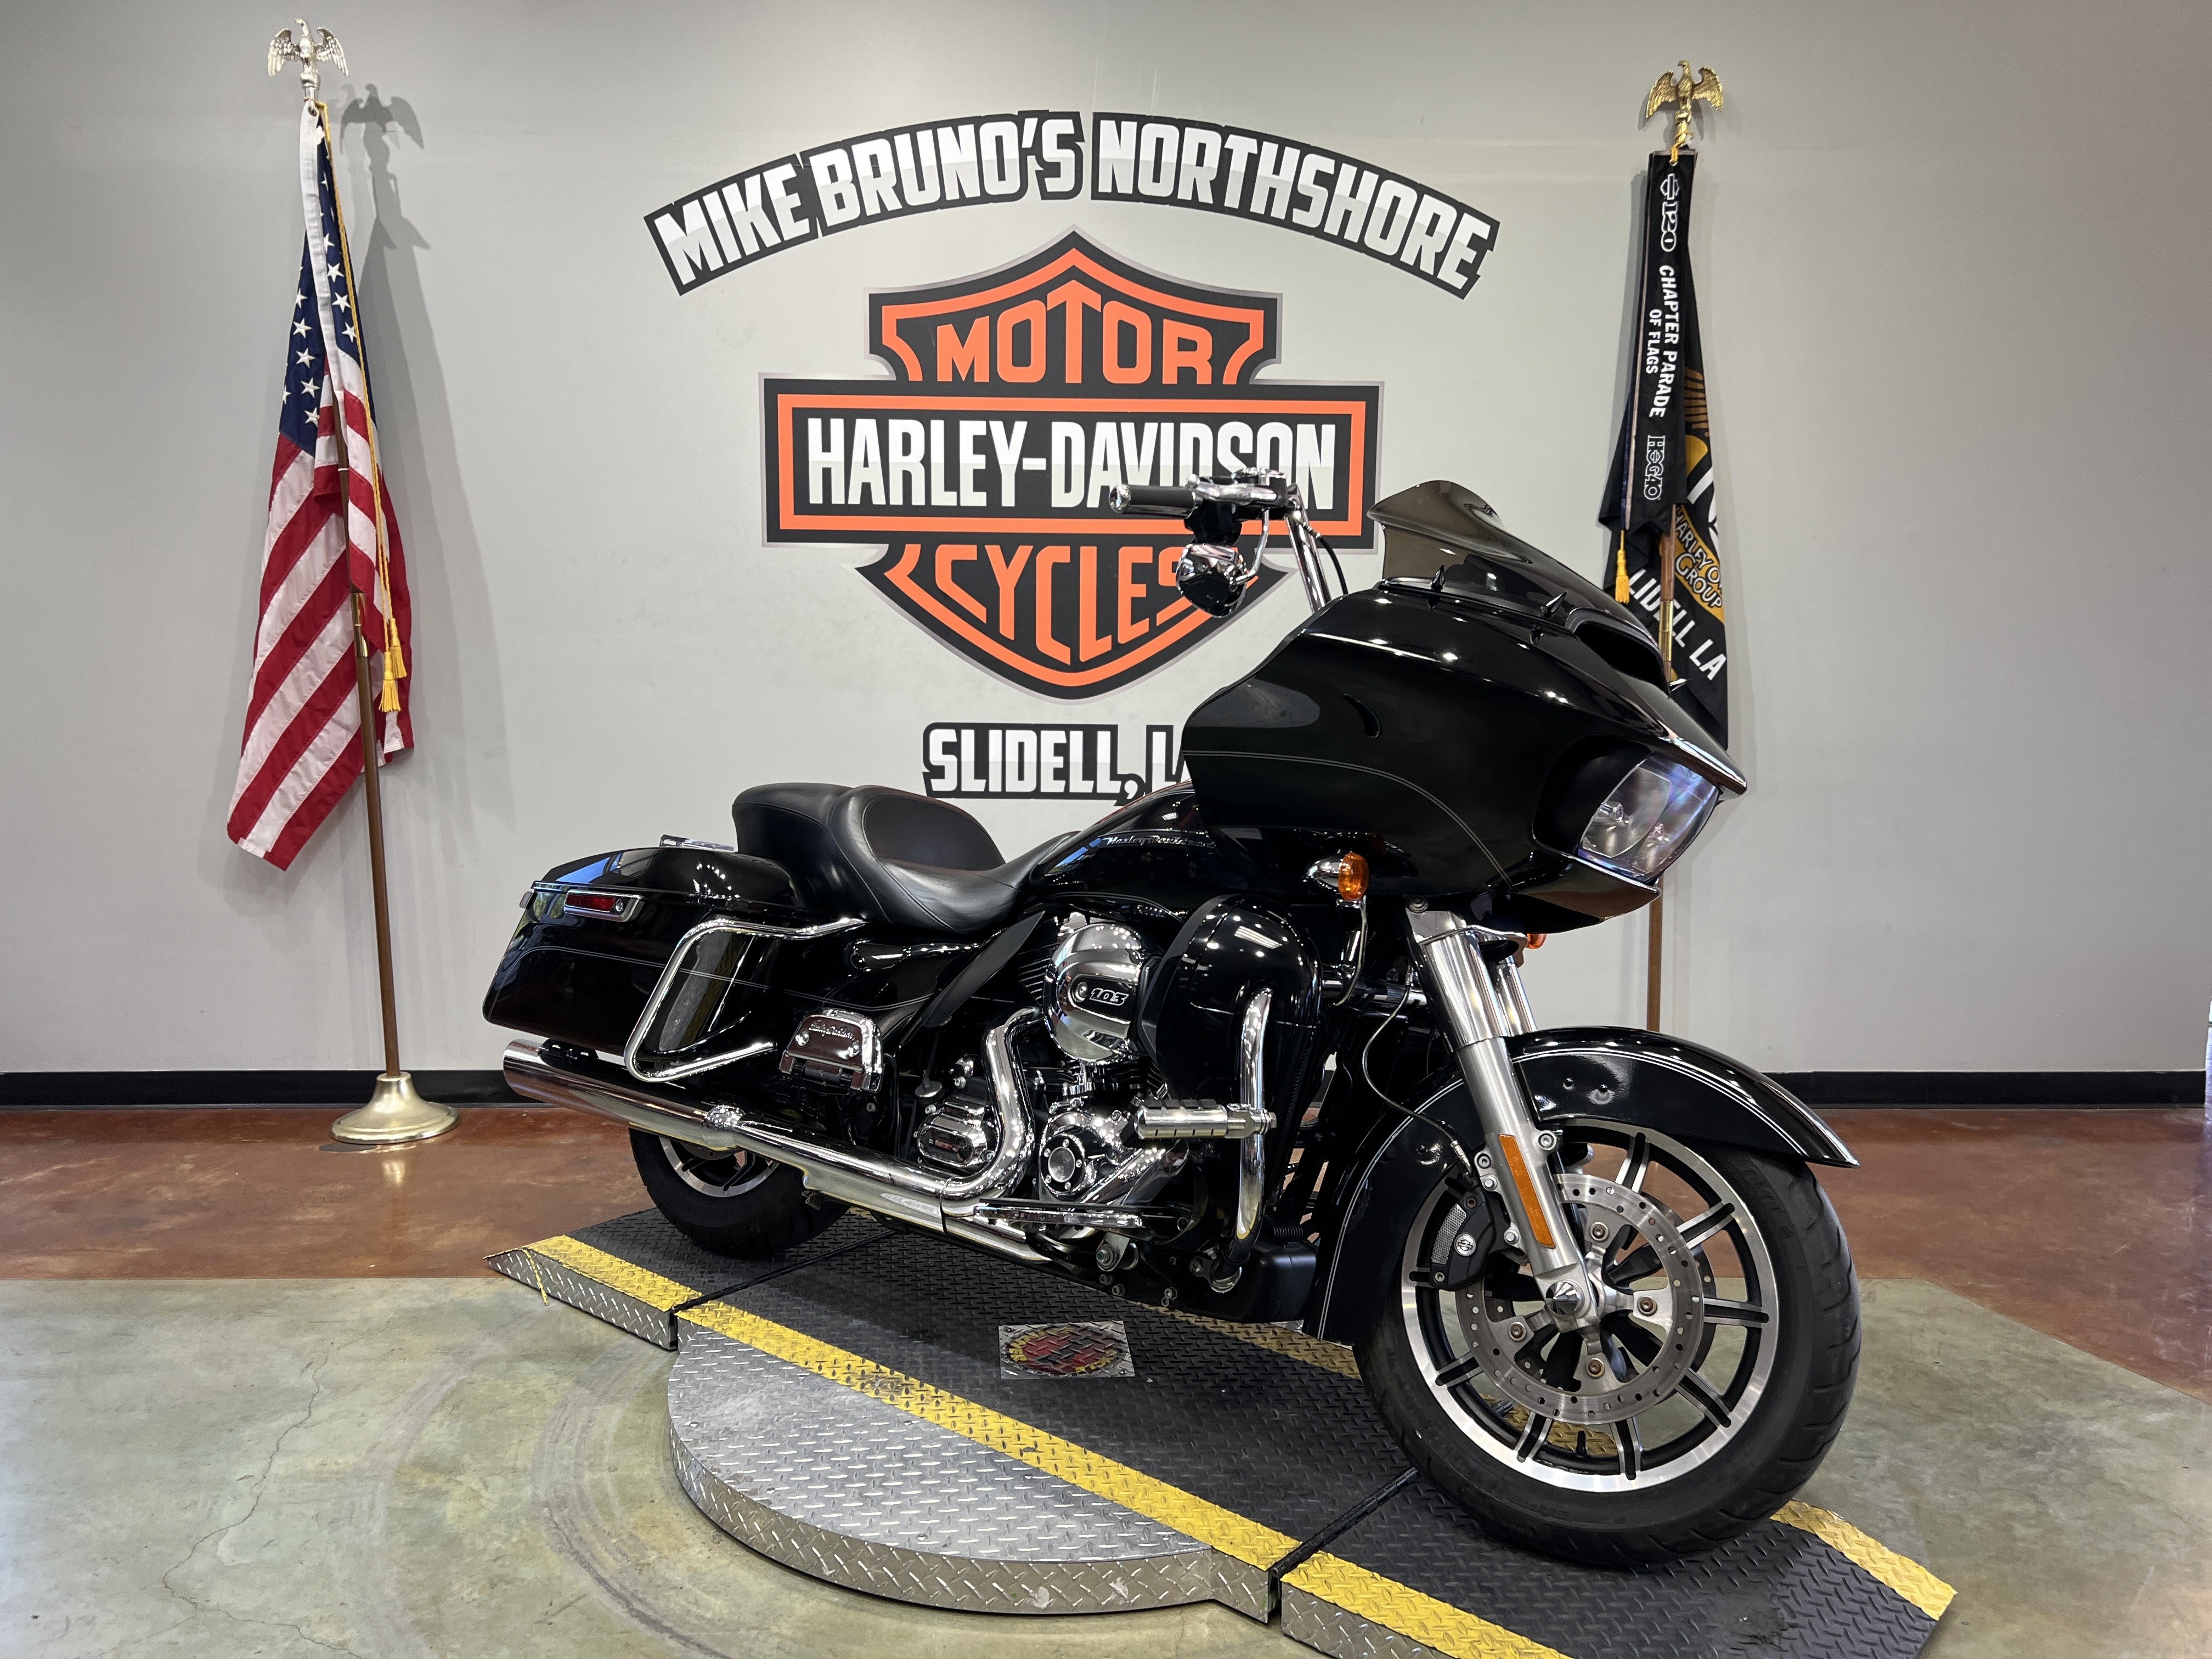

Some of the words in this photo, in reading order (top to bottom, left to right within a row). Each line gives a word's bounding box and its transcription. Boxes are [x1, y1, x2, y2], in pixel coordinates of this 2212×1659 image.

[654, 163, 810, 285] MIKE
[809, 117, 1075, 227] BRUNO'S
[1098, 119, 1491, 290] NORTHSHORE
[937, 279, 1212, 385] MOTOR
[1649, 309, 1662, 326] OF
[1659, 264, 1679, 345] CHAPTER
[1646, 330, 1661, 374] FLAGS
[1649, 351, 1676, 418] PARADE
[808, 417, 1336, 510] HARLEY-DAVIDSON
[1675, 553, 1722, 607] GROUP
[1689, 639, 1726, 680] LA
[929, 729, 1138, 799] SLIDELL,
[1153, 731, 1192, 793] L
[1089, 988, 1129, 1006] 103
